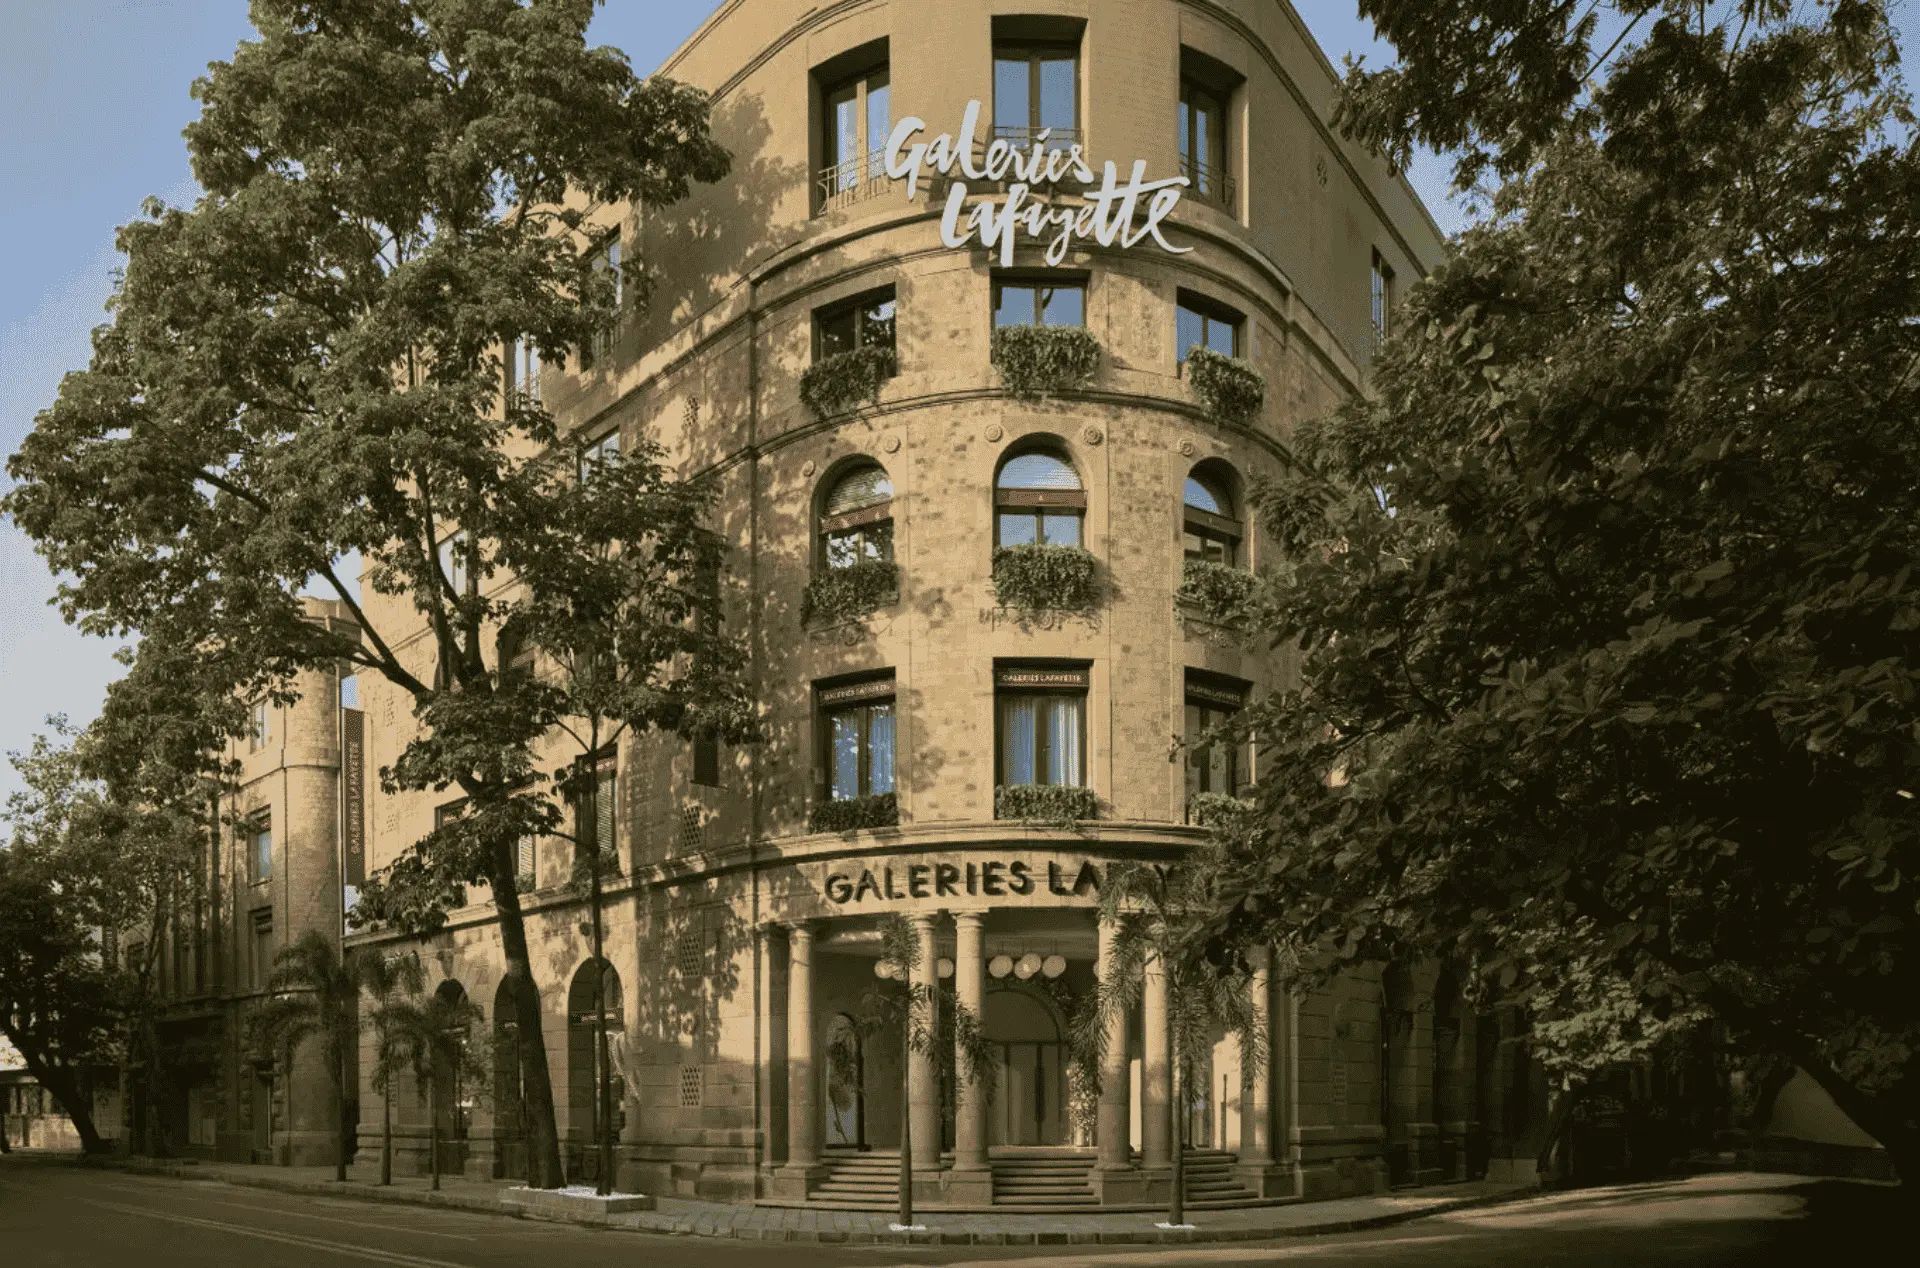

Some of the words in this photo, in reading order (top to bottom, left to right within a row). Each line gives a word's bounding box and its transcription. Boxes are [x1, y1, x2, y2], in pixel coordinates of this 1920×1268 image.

[884, 99, 1094, 200] Galeries
[940, 160, 1194, 267] Lafayette
[824, 860, 1038, 904] GALERIES
